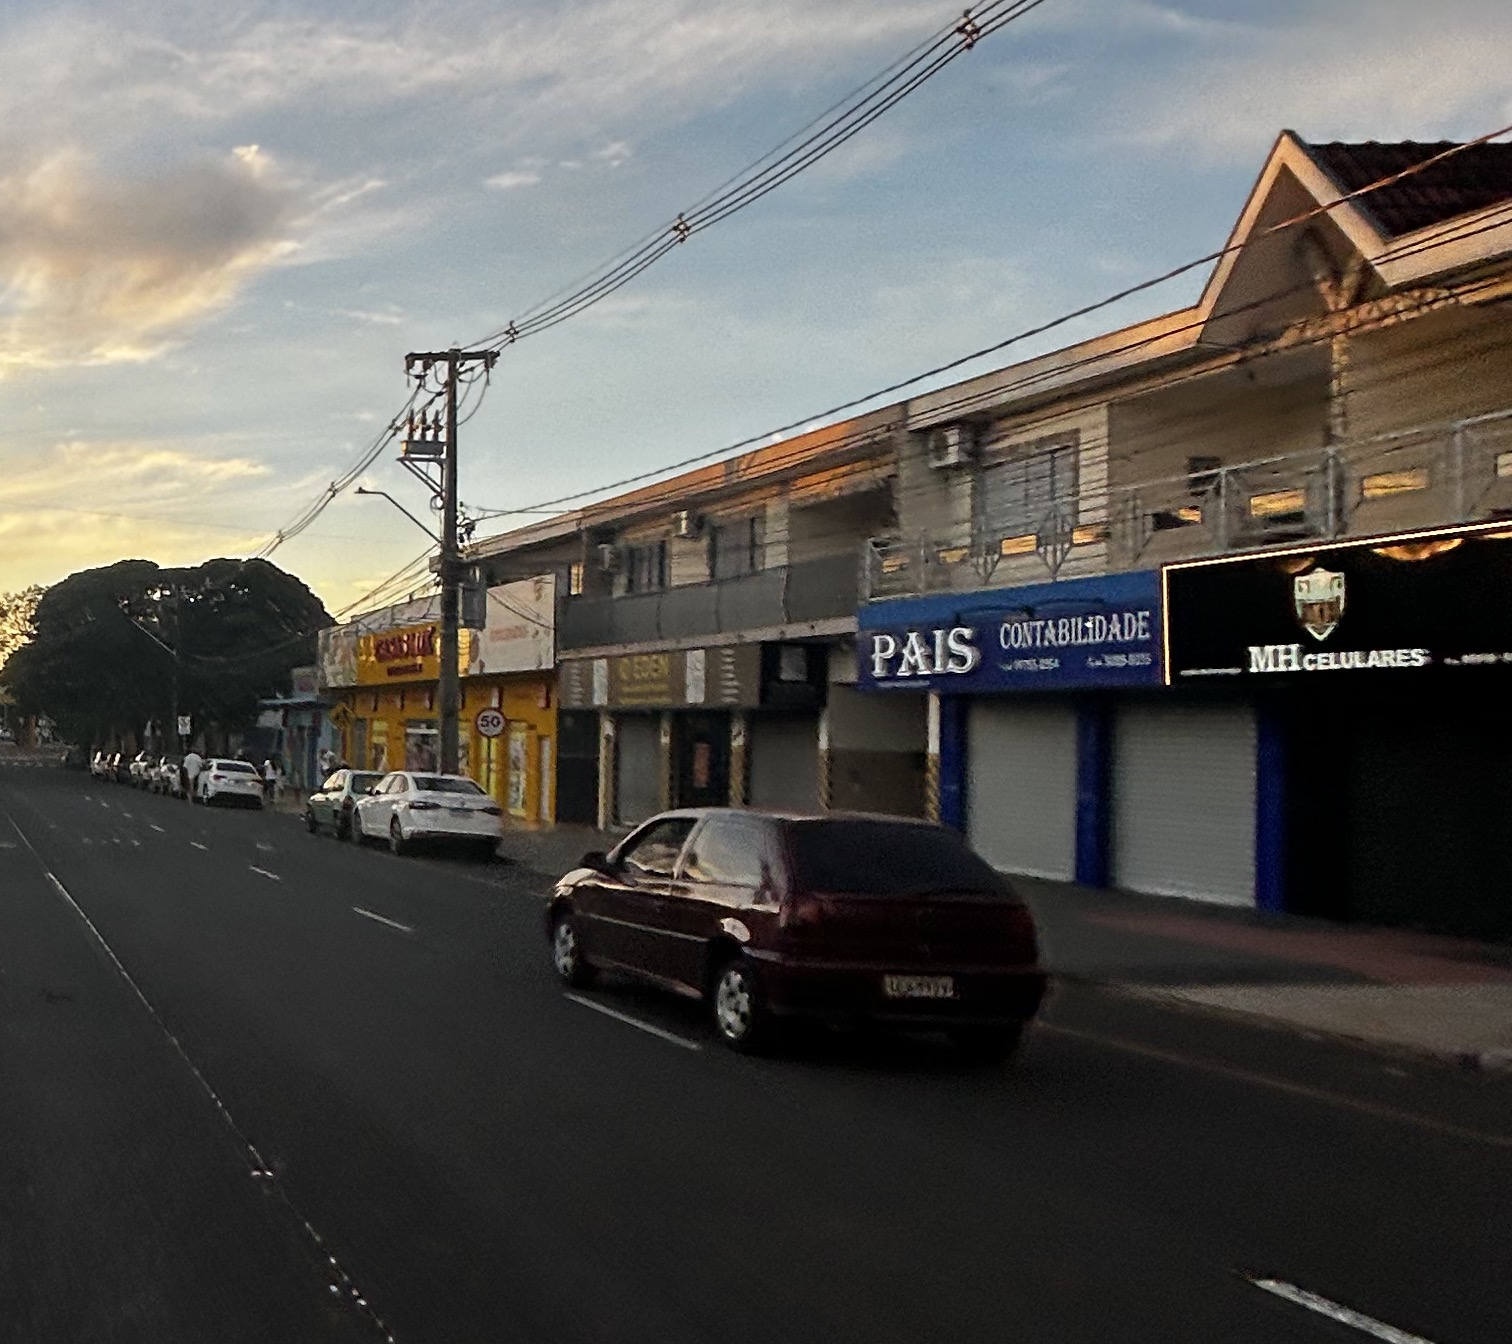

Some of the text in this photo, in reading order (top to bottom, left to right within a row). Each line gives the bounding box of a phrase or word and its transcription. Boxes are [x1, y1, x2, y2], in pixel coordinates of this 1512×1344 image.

[872, 610, 1151, 678] PAIS CONTABILIDADE
[1247, 643, 1303, 673] MH
[1302, 649, 1427, 671] CELULARES
[480, 715, 501, 728] 50
